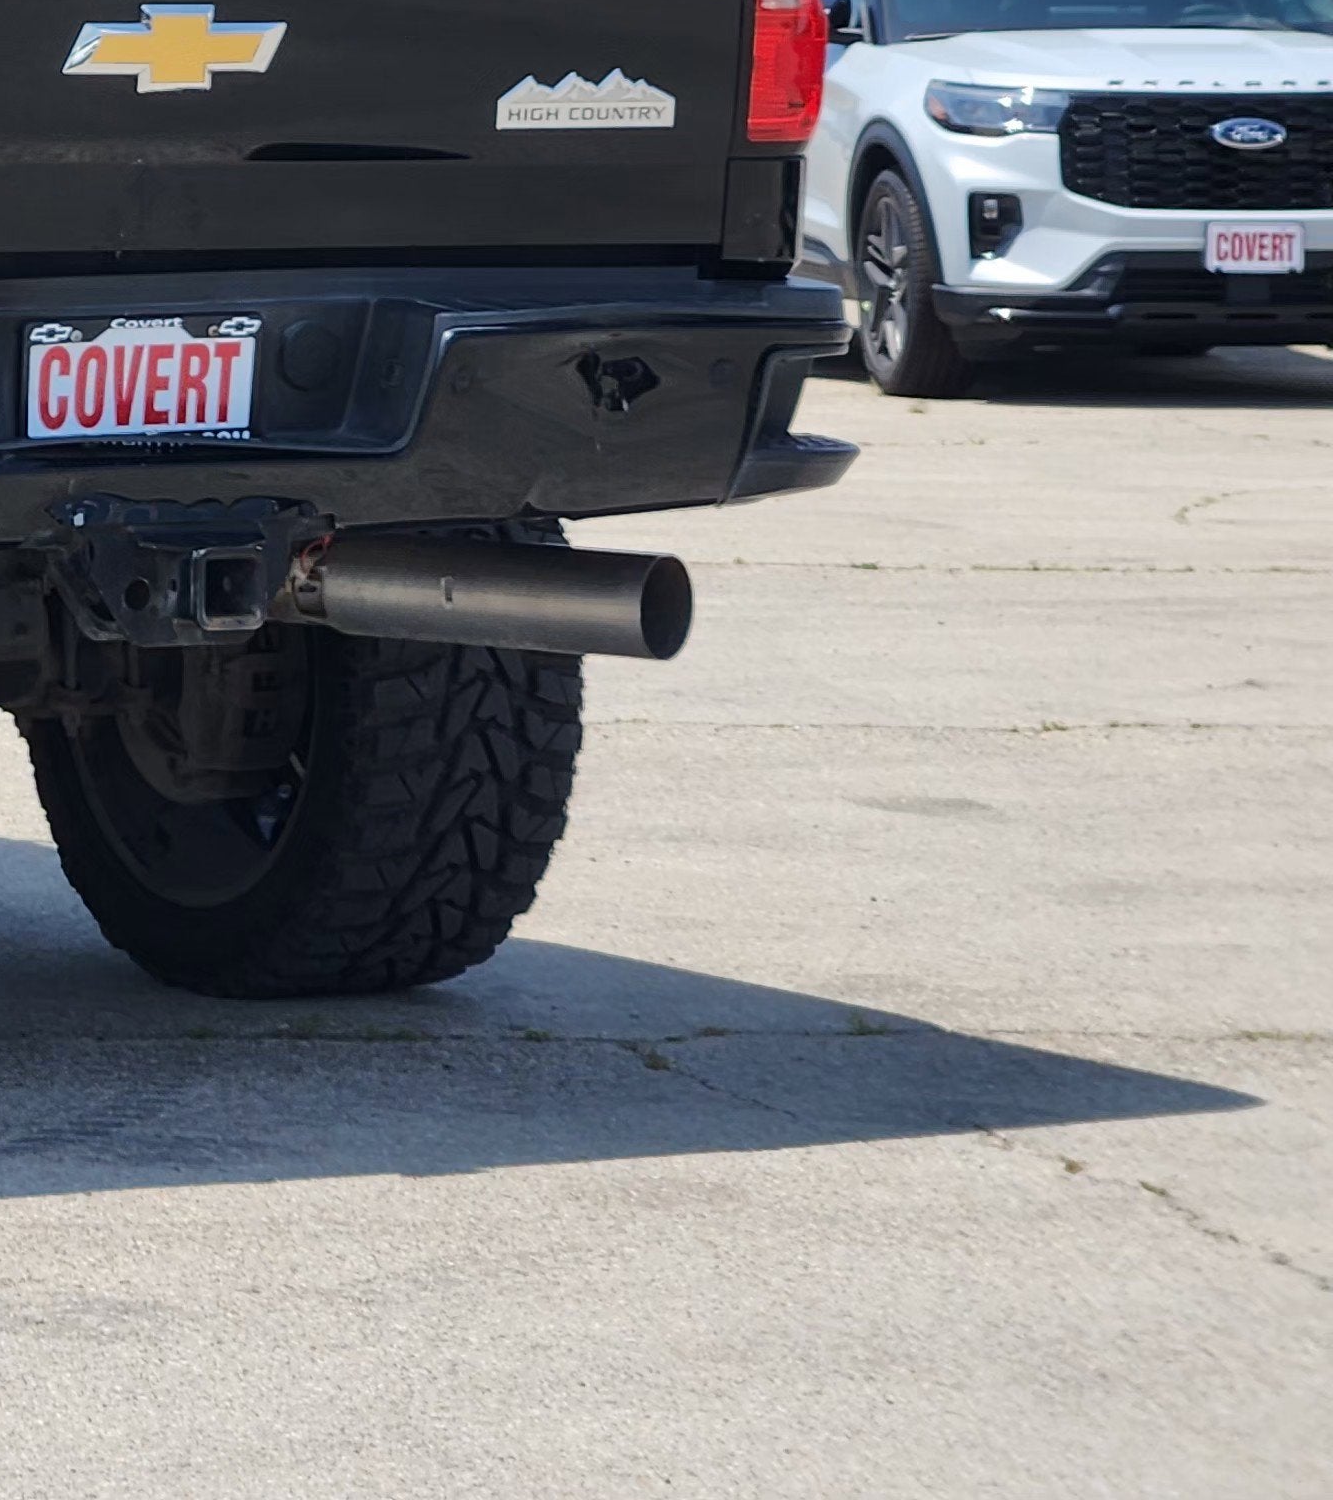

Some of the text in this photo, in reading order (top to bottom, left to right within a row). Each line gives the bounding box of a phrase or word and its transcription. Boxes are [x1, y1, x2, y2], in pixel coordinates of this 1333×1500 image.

[507, 106, 667, 121] HIGH COUNTRY
[1216, 231, 1296, 262] COVERT
[109, 316, 184, 329] Covert
[37, 341, 242, 431] COVERT
